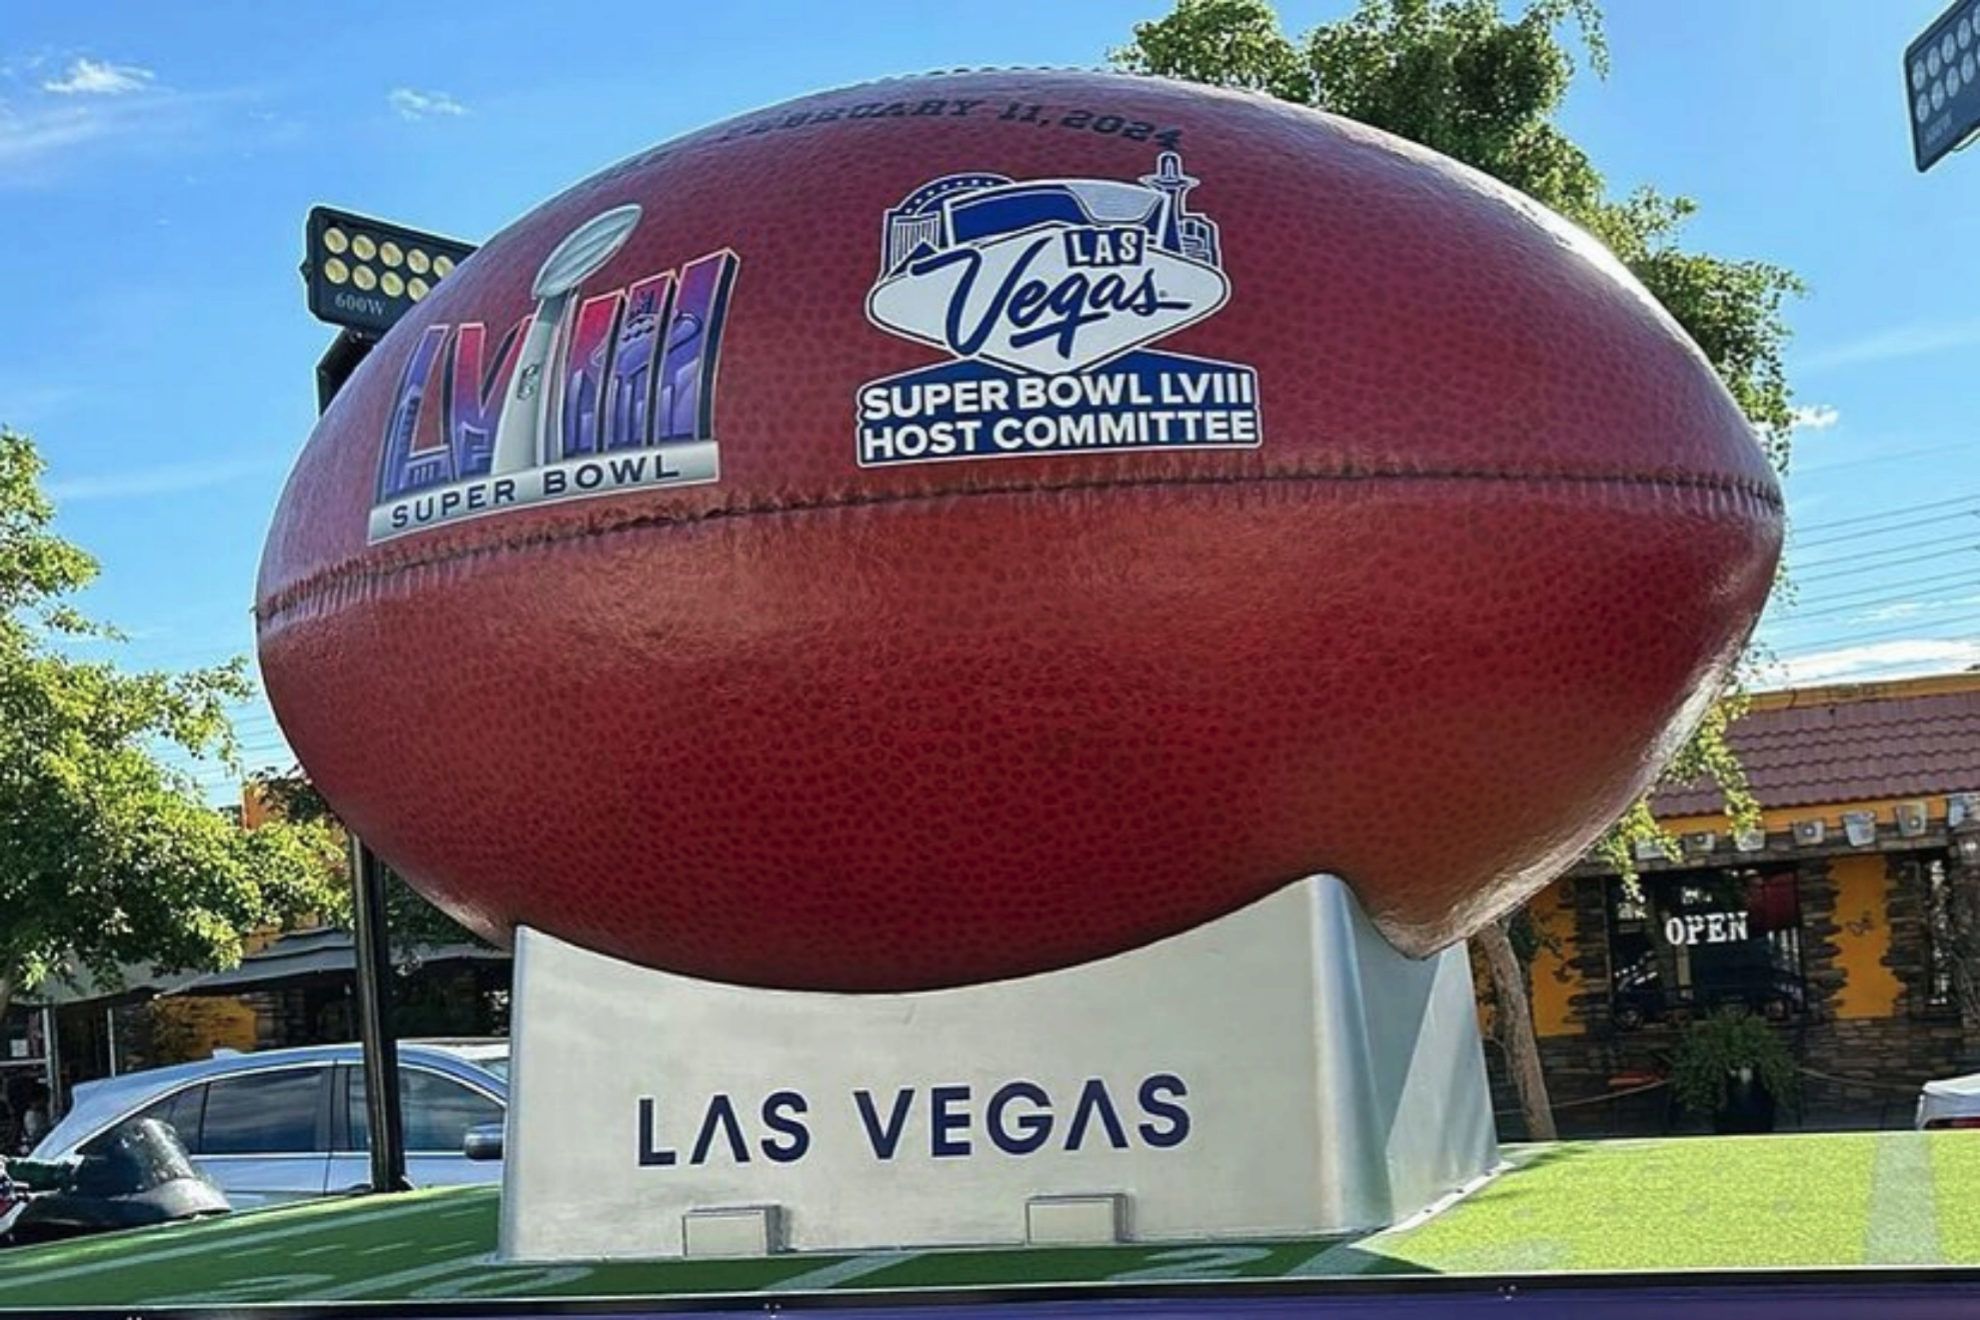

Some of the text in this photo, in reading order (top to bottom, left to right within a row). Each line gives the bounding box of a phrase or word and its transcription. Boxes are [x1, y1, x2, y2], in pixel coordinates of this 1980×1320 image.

[1071, 233, 1139, 264] LAS
[911, 236, 1192, 359] Vegas
[862, 371, 1252, 419] SUPER BOWL LVIII
[864, 411, 1256, 460] HOST COMMITTEE
[391, 454, 680, 529] SUPER BOWL
[1664, 911, 1748, 945] OPEN
[638, 1073, 1191, 1166] LAS VEGAS
